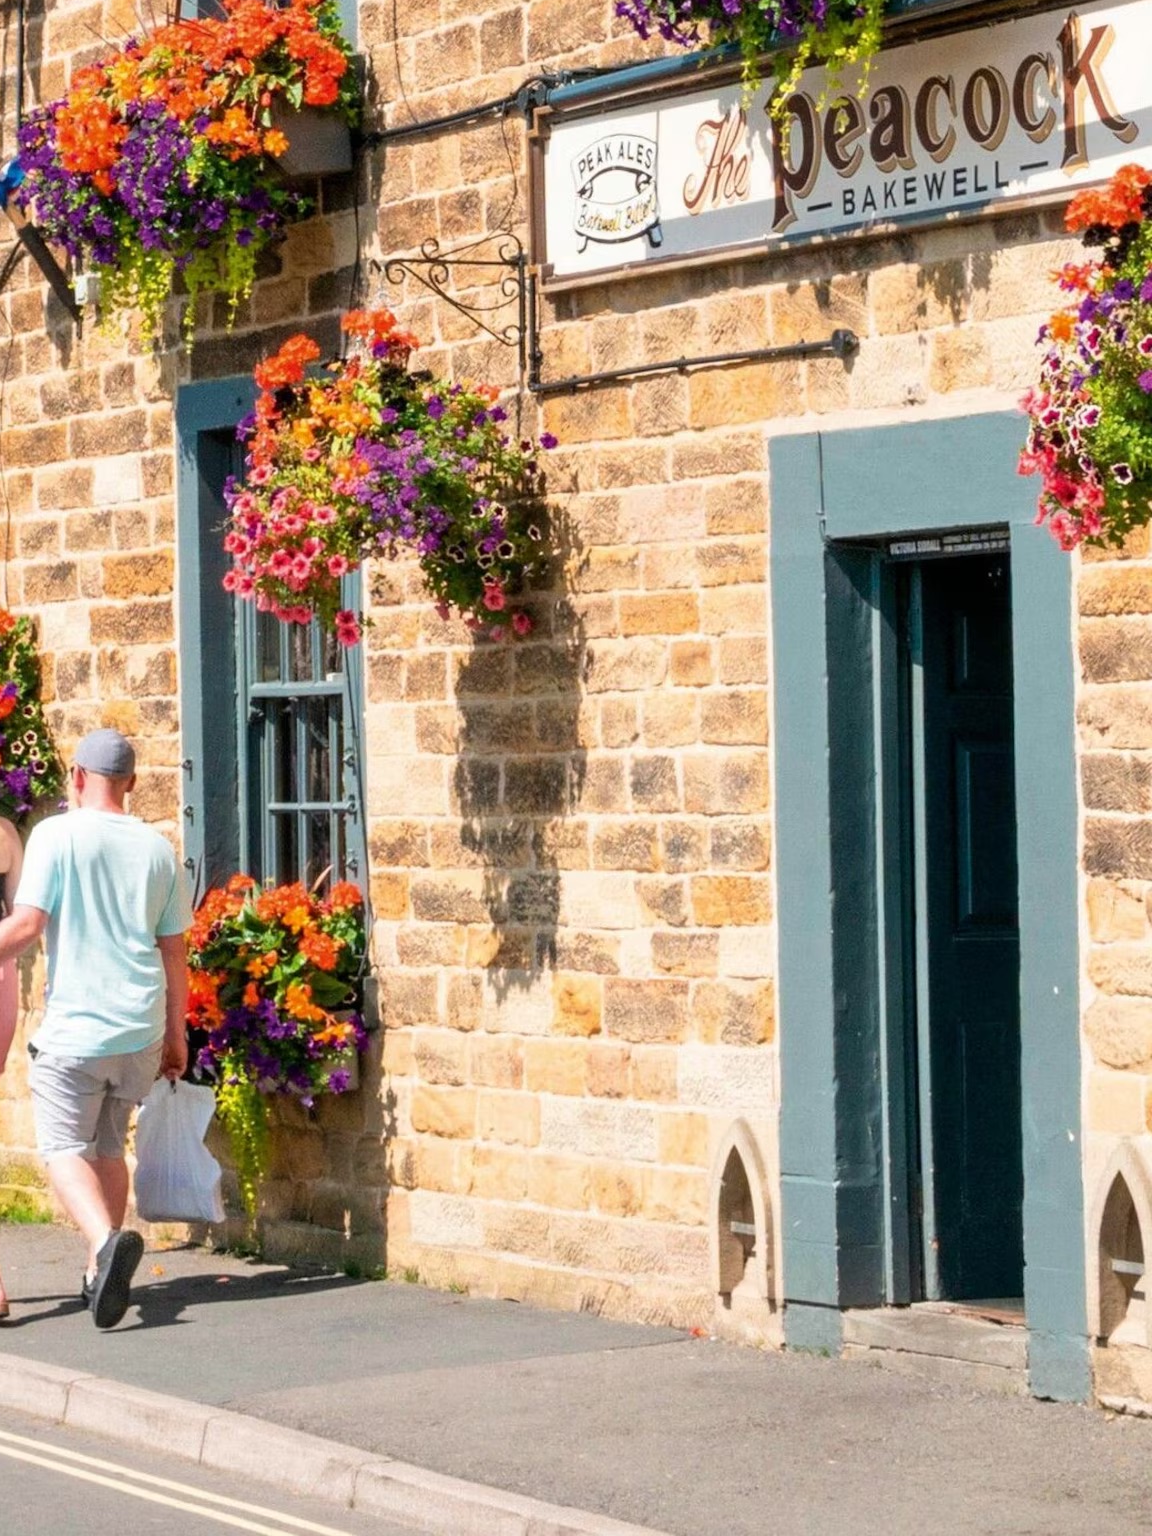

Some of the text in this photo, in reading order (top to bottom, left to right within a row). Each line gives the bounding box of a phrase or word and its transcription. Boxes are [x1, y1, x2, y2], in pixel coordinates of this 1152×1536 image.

[578, 141, 653, 179] PEAK ALES
[683, 107, 750, 215] The
[842, 161, 1009, 215] BAKEWELL
